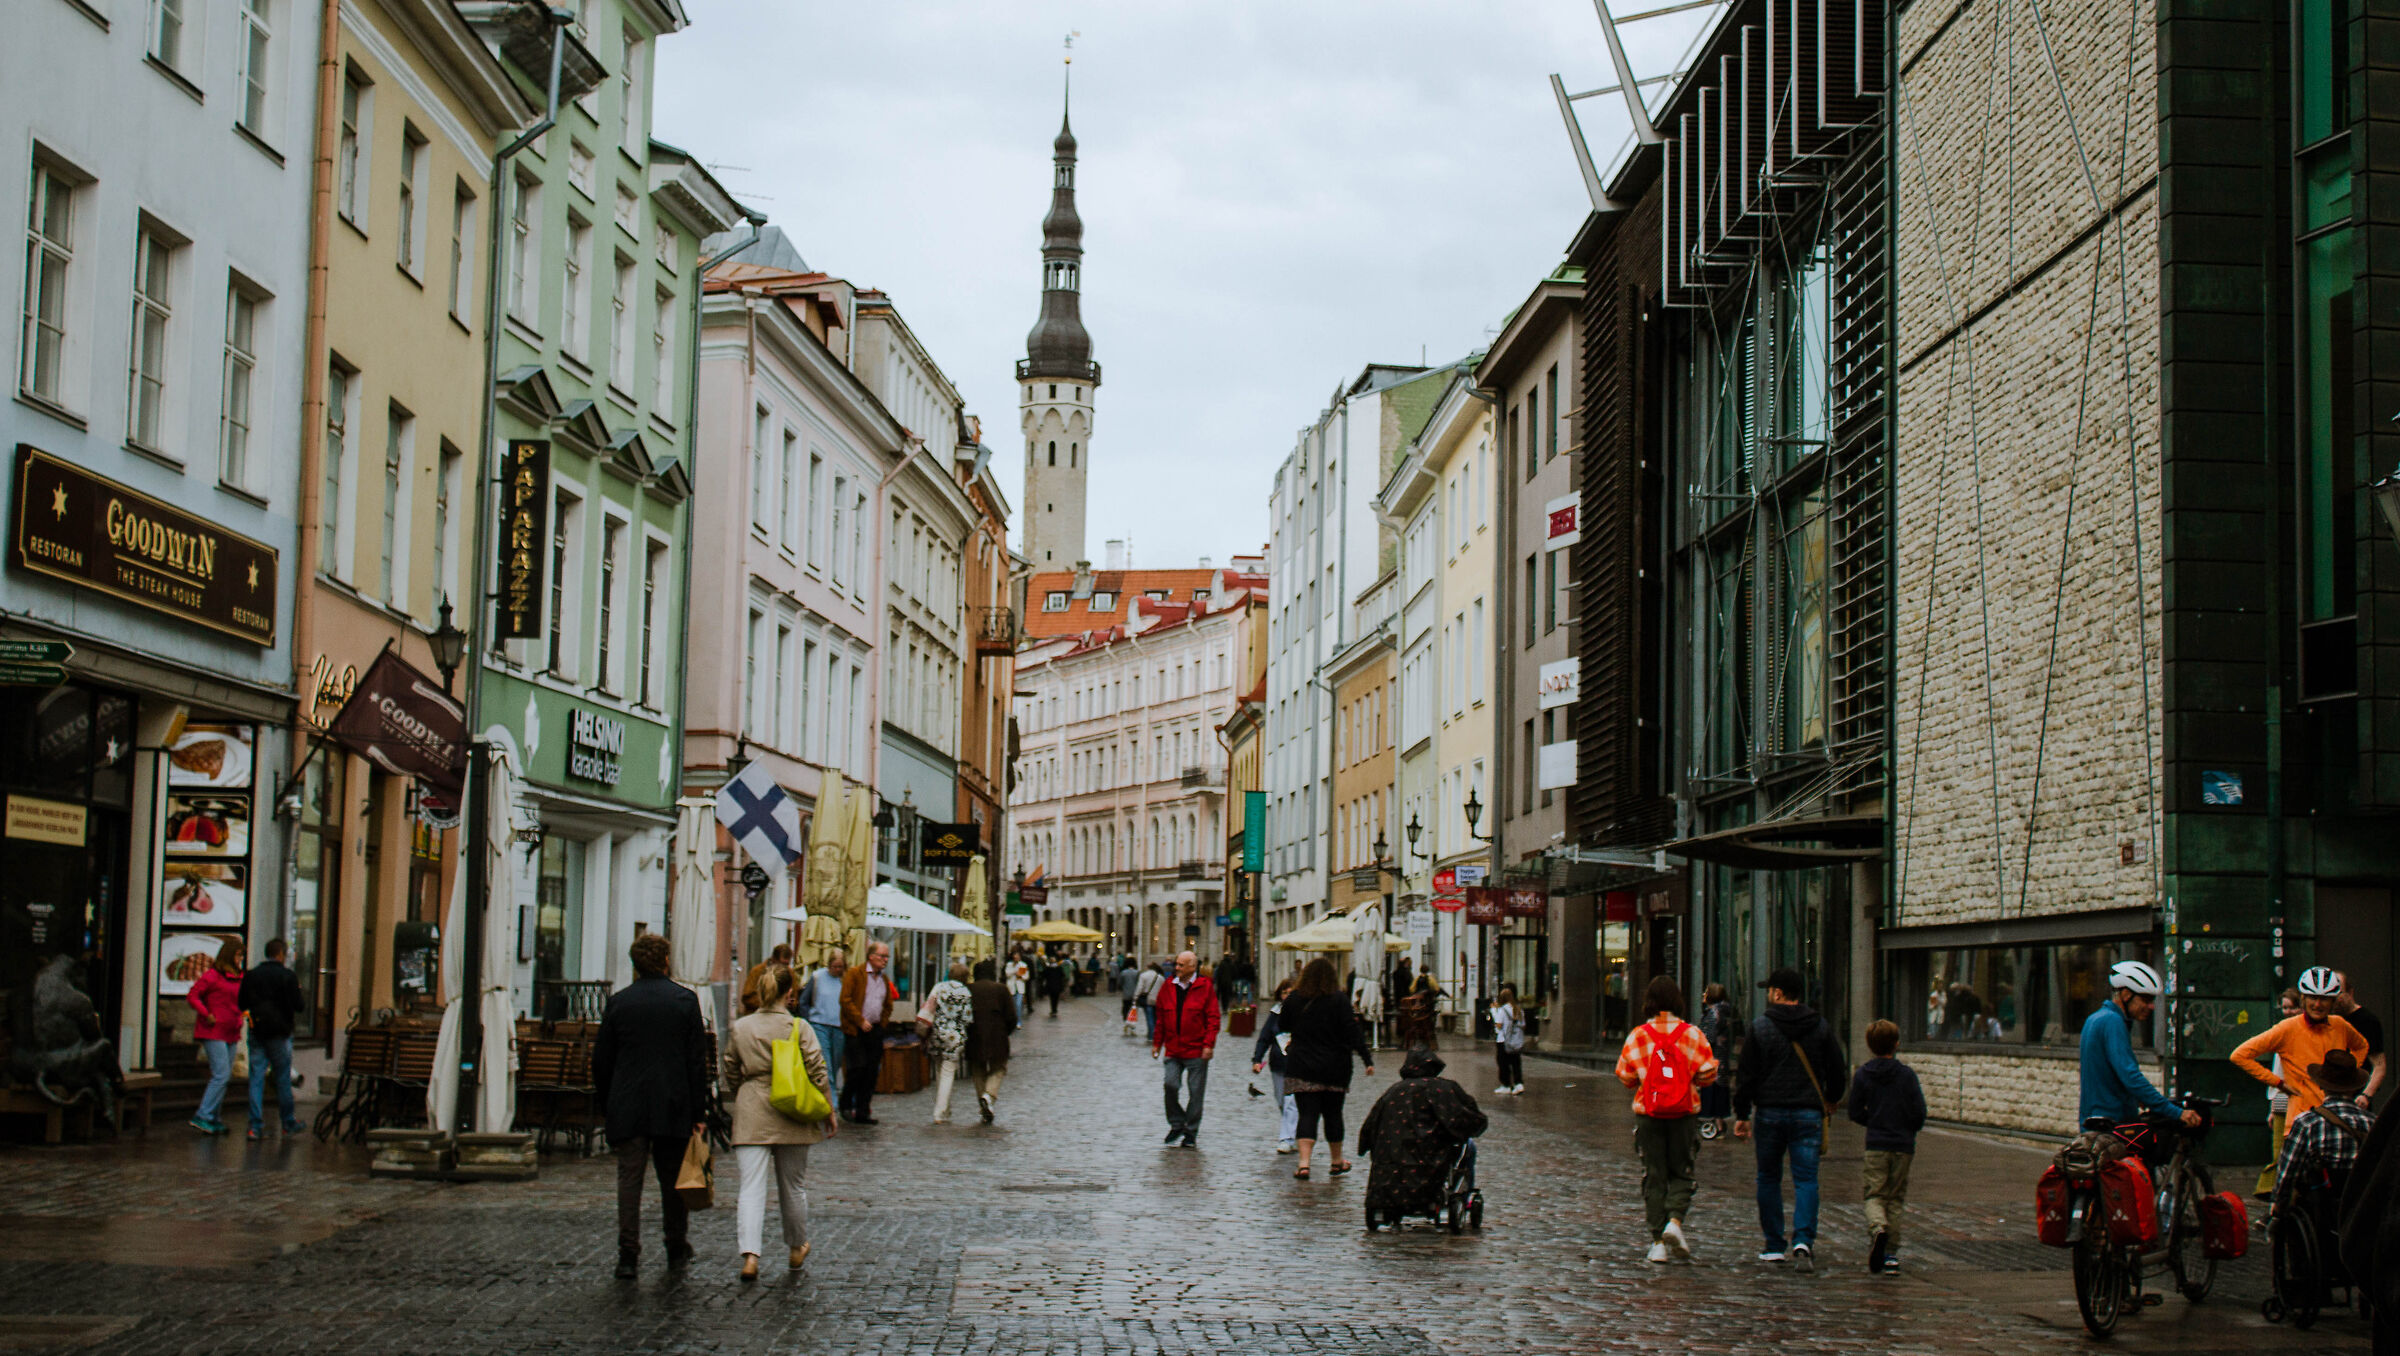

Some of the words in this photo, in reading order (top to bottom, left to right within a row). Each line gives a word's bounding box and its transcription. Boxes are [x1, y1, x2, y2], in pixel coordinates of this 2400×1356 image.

[30, 535, 83, 567] RESTORAN
[107, 499, 217, 580] GOODWIN
[508, 444, 536, 633] PAPARAZZI
[117, 566, 135, 586] THE
[138, 574, 169, 598] STEAK
[172, 586, 202, 608] HOUSE
[232, 606, 269, 632] RESTORAN
[573, 708, 625, 756] HELSINKI
[571, 743, 604, 782] karaoke
[924, 849, 949, 857] SOFT
[949, 849, 975, 857] GOLD
